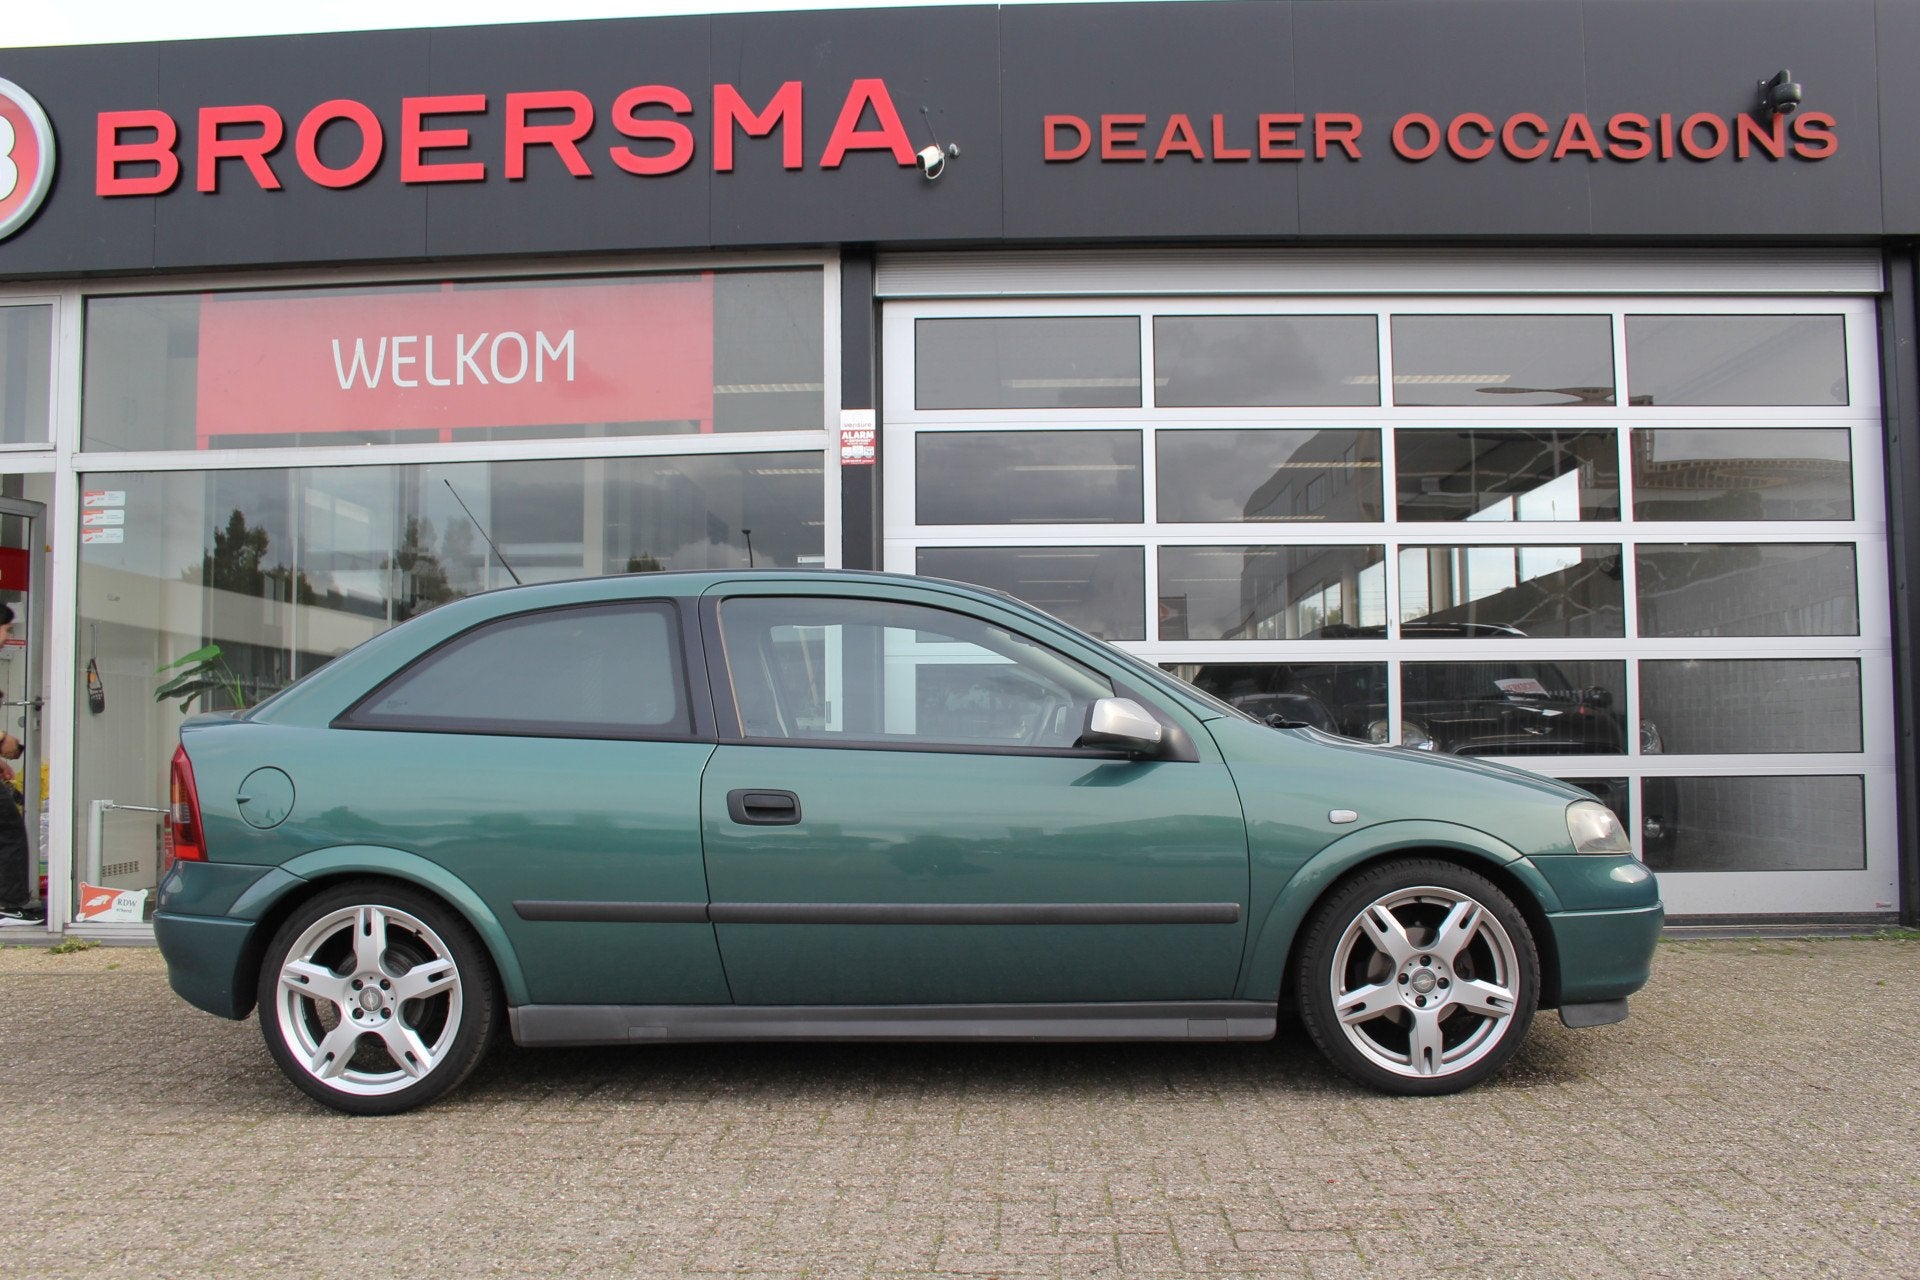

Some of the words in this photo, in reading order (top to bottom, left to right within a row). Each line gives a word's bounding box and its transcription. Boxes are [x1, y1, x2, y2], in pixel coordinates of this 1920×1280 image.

[96, 78, 917, 196] BROERSMA
[1044, 113, 1363, 161] DEALER
[1393, 112, 1838, 161] OCCASIONS
[332, 330, 575, 389] WELKOM
[842, 431, 874, 440] ALARM
[117, 898, 137, 906] RDW
